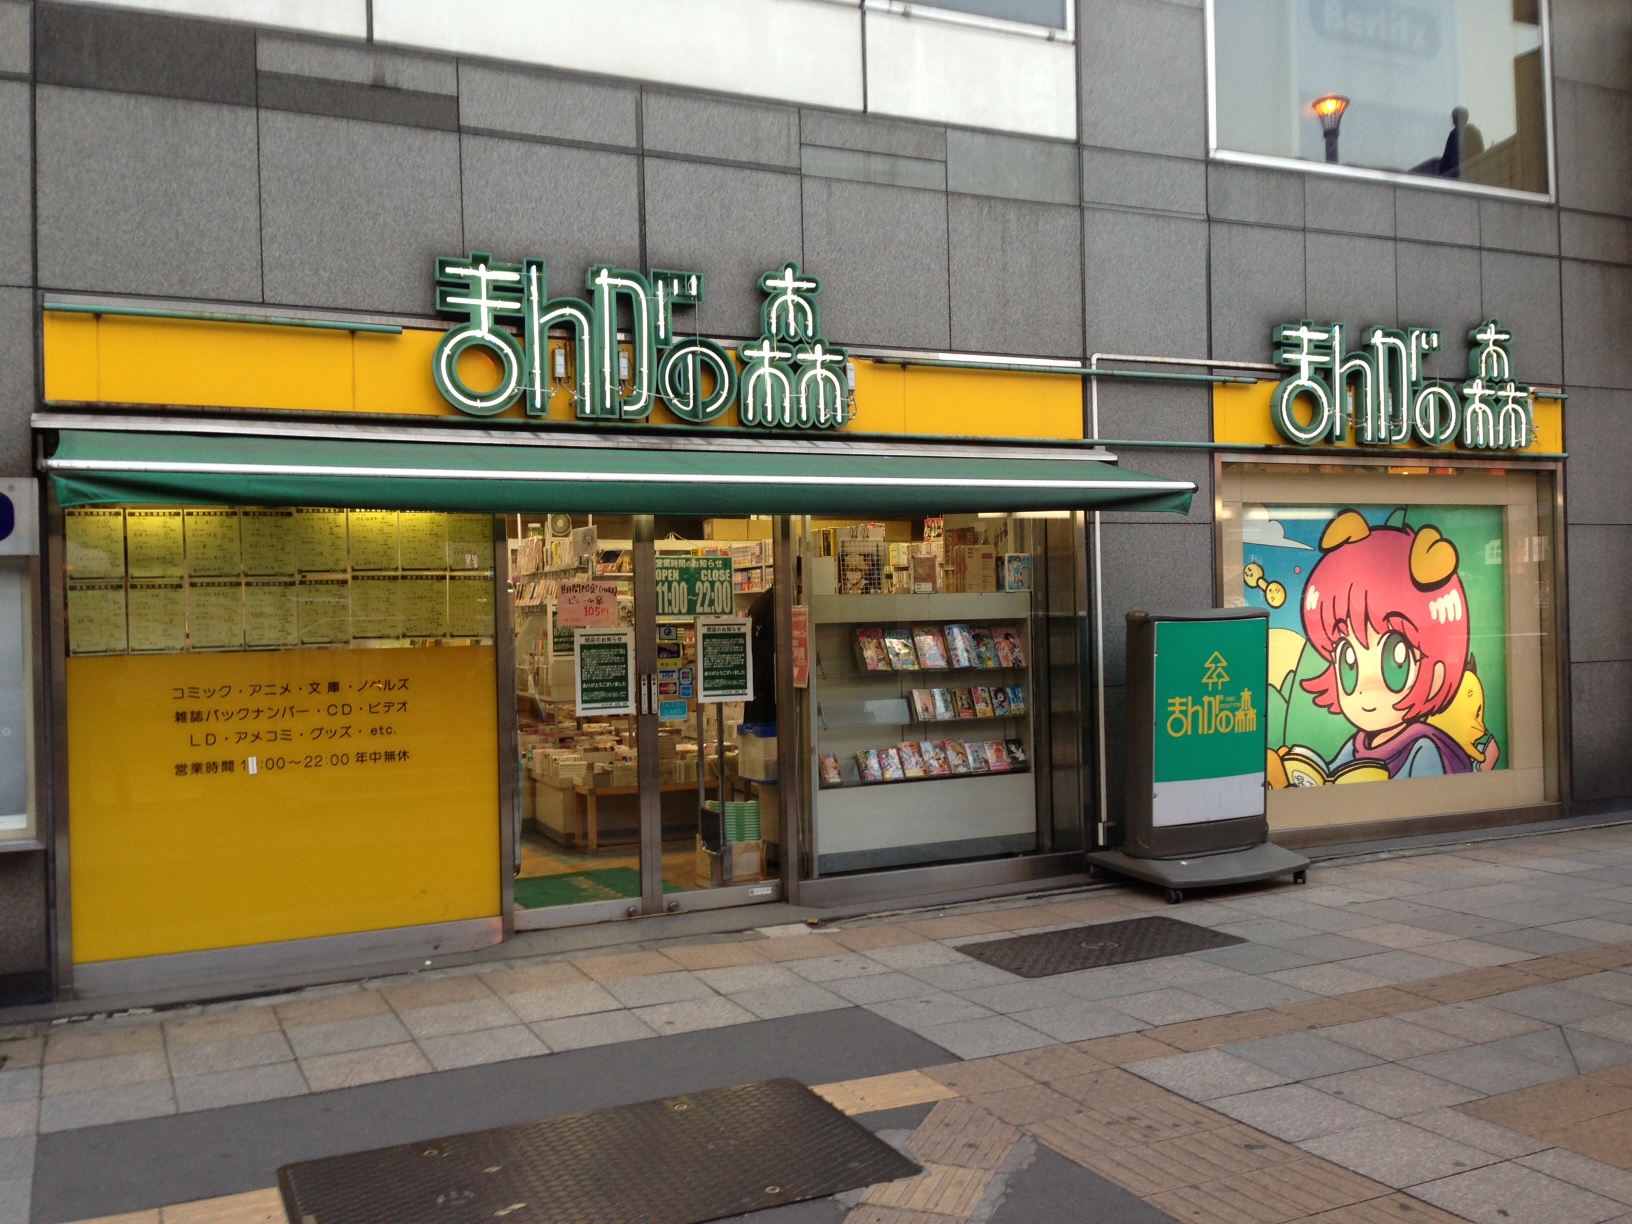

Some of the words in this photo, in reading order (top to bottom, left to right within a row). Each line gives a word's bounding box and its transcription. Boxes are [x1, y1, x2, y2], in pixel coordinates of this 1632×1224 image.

[432, 251, 849, 428] まんがの森
[1271, 318, 1531, 449] まんがの森
[655, 558, 723, 568] 営業時間のお知らせ
[655, 569, 680, 581] OPEN
[700, 569, 731, 581] CLOSE
[583, 605, 609, 617] 105円
[1166, 688, 1257, 738] まんがの森
[354, 750, 410, 765] 年中無休
